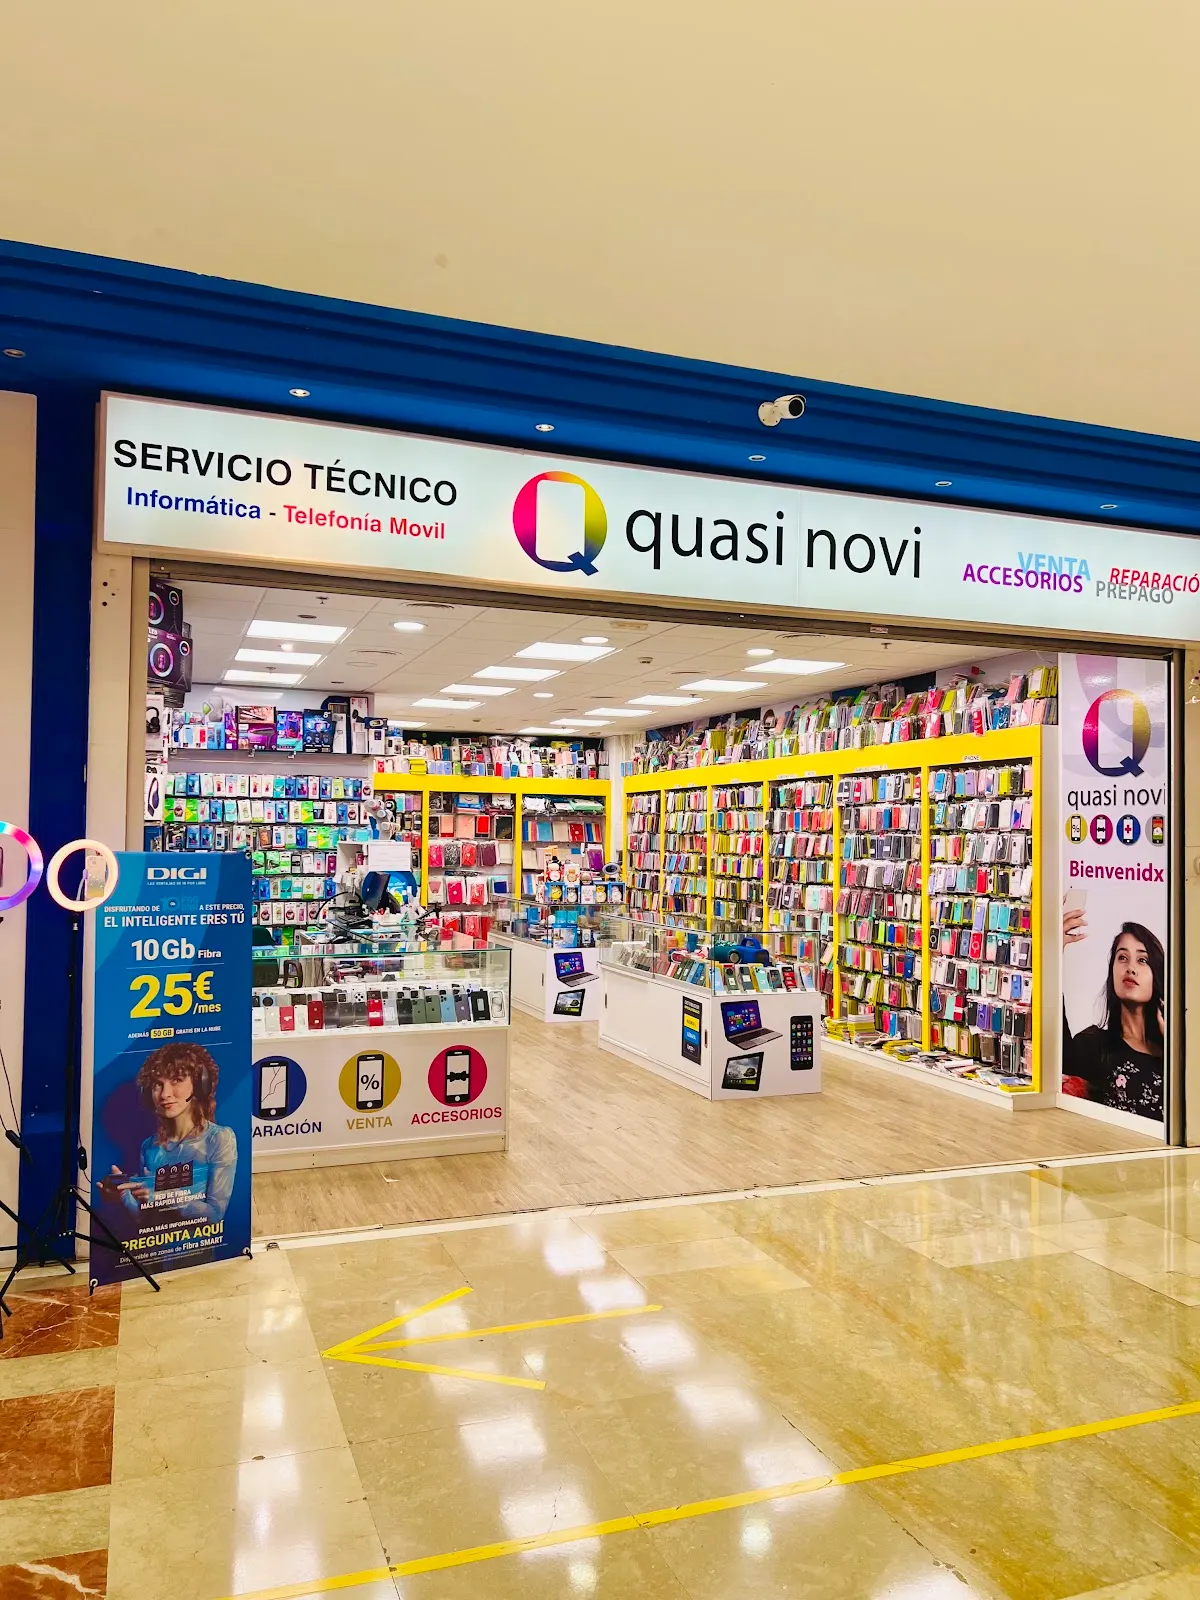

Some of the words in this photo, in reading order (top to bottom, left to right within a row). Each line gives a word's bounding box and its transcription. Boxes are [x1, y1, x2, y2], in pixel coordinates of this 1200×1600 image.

[113, 439, 292, 486] SERVICIO
[303, 459, 457, 506] TÉCNICO
[127, 486, 262, 519] Informática
[283, 504, 382, 533] Telefonía
[390, 517, 445, 539] Movil
[512, 470, 608, 576] Q
[626, 509, 785, 570] quasi
[806, 526, 922, 578] novi
[1017, 551, 1091, 581] VENTA
[962, 563, 1083, 593] ACCESORIOS
[1096, 580, 1174, 604] PREPAGO
[1067, 784, 1117, 810] quasi
[1123, 782, 1166, 806] novi
[147, 867, 207, 880] DIGI
[1069, 860, 1165, 882] Bienvenidx
[104, 905, 151, 913] DISFRUTANDO
[221, 903, 245, 911] PRECIO,
[104, 916, 119, 928] EL
[121, 914, 197, 927] INTELIGENTE
[200, 913, 228, 925] ERES
[230, 911, 245, 924] TÚ
[131, 939, 159, 961] 10
[161, 937, 196, 960] Gb
[197, 950, 222, 959] Fibra
[129, 971, 214, 1018] 25€
[192, 1002, 222, 1014] /mes
[163, 1029, 172, 1037] GB
[346, 1116, 393, 1130] VENTA
[410, 1107, 502, 1125] ACCESORIOS
[252, 1118, 322, 1138] ARACIÓN
[141, 1201, 154, 1210] MÁS
[155, 1193, 167, 1201] RED
[139, 1227, 155, 1235] PARA
[155, 1223, 169, 1232] MÁS
[169, 1216, 208, 1229] INFORMACIÓN
[193, 1220, 225, 1239] AQUÍ
[157, 1246, 175, 1256] zonas
[174, 1244, 182, 1252] de
[182, 1241, 199, 1251] Fibra
[199, 1235, 224, 1247] SMART
